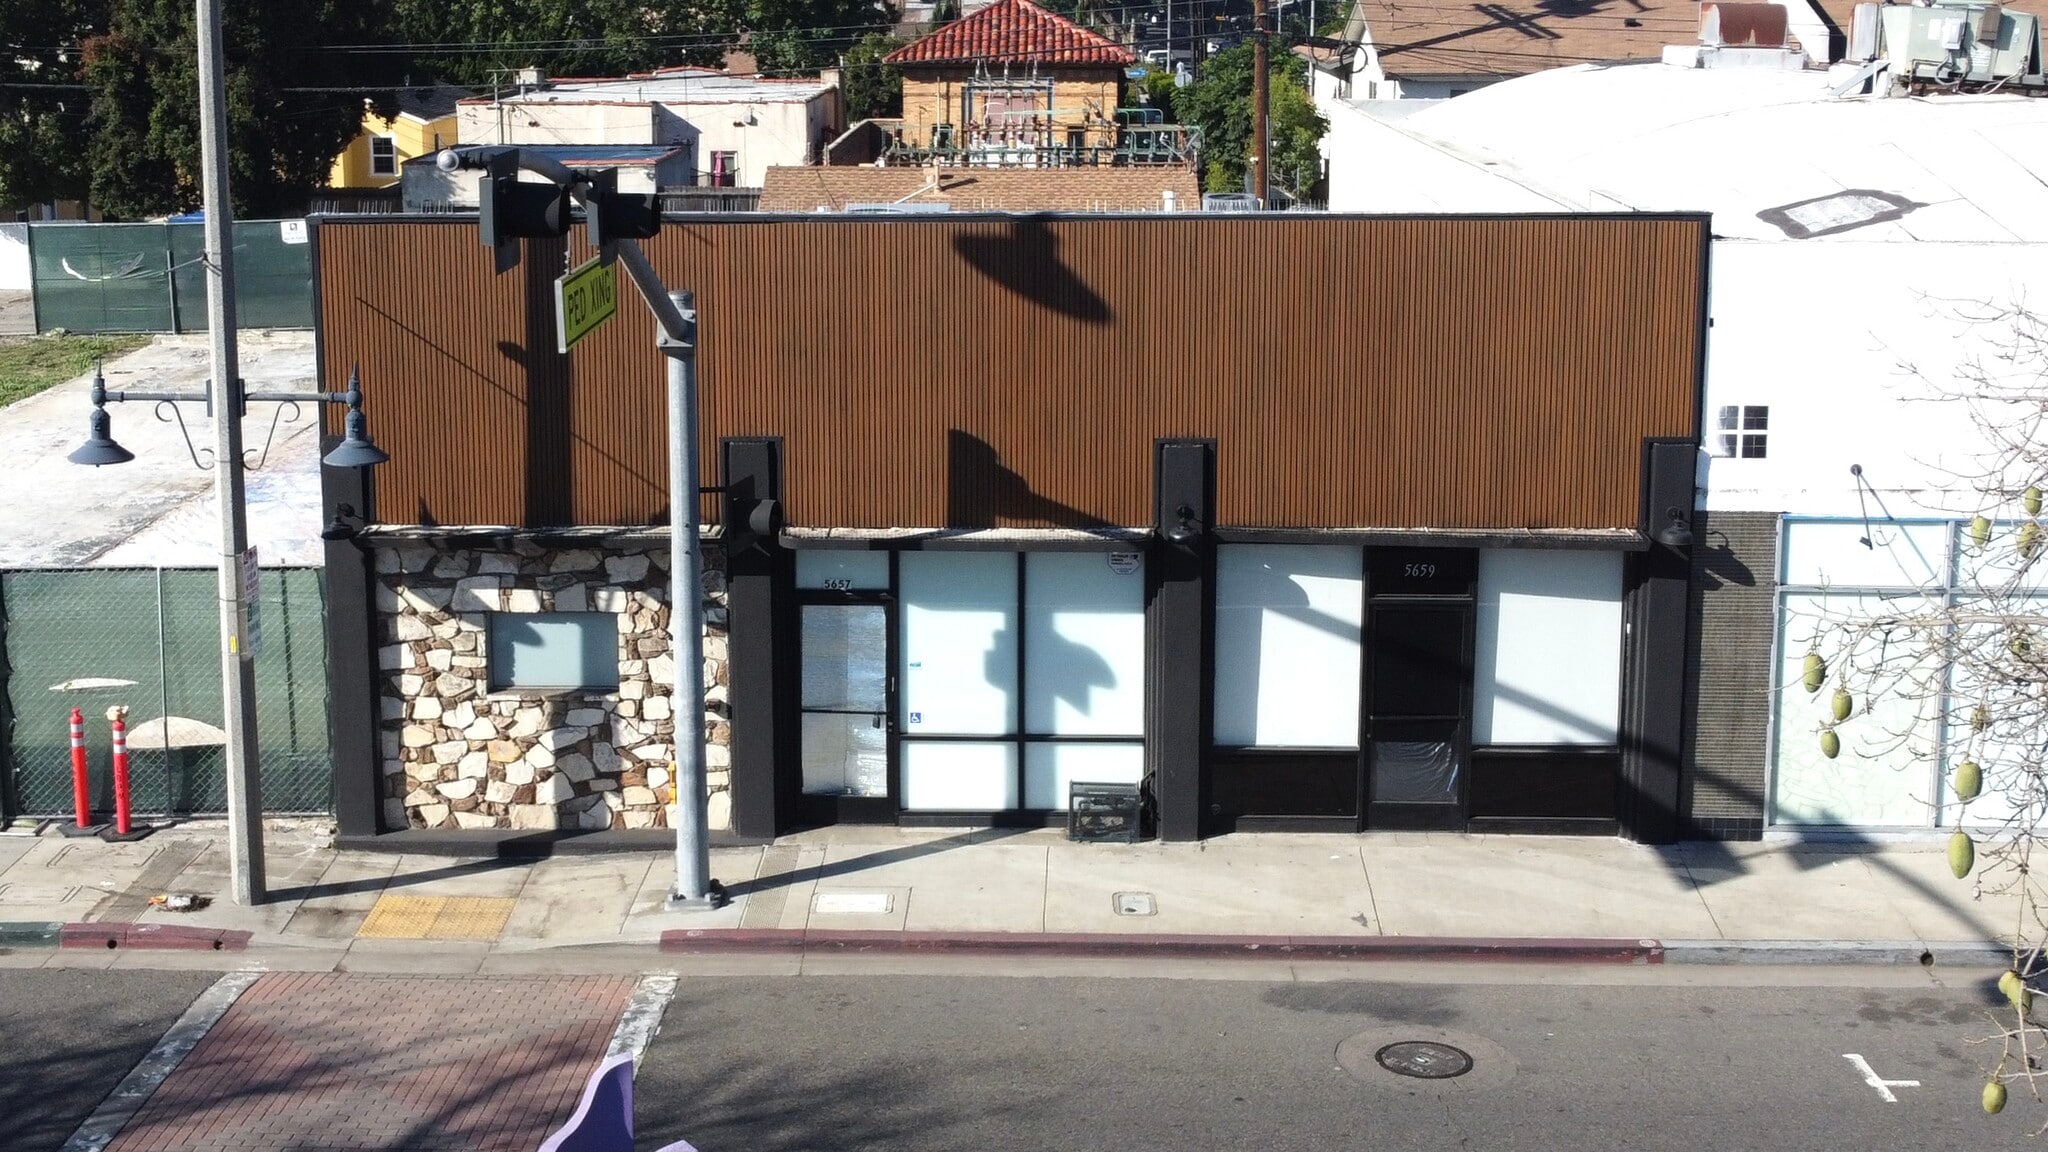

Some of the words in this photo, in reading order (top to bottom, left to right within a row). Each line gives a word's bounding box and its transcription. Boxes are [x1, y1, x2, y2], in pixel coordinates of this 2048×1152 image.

[567, 286, 587, 331] PED
[589, 269, 611, 315] XING
[1404, 563, 1436, 578] 5659
[823, 579, 851, 589] 5657
